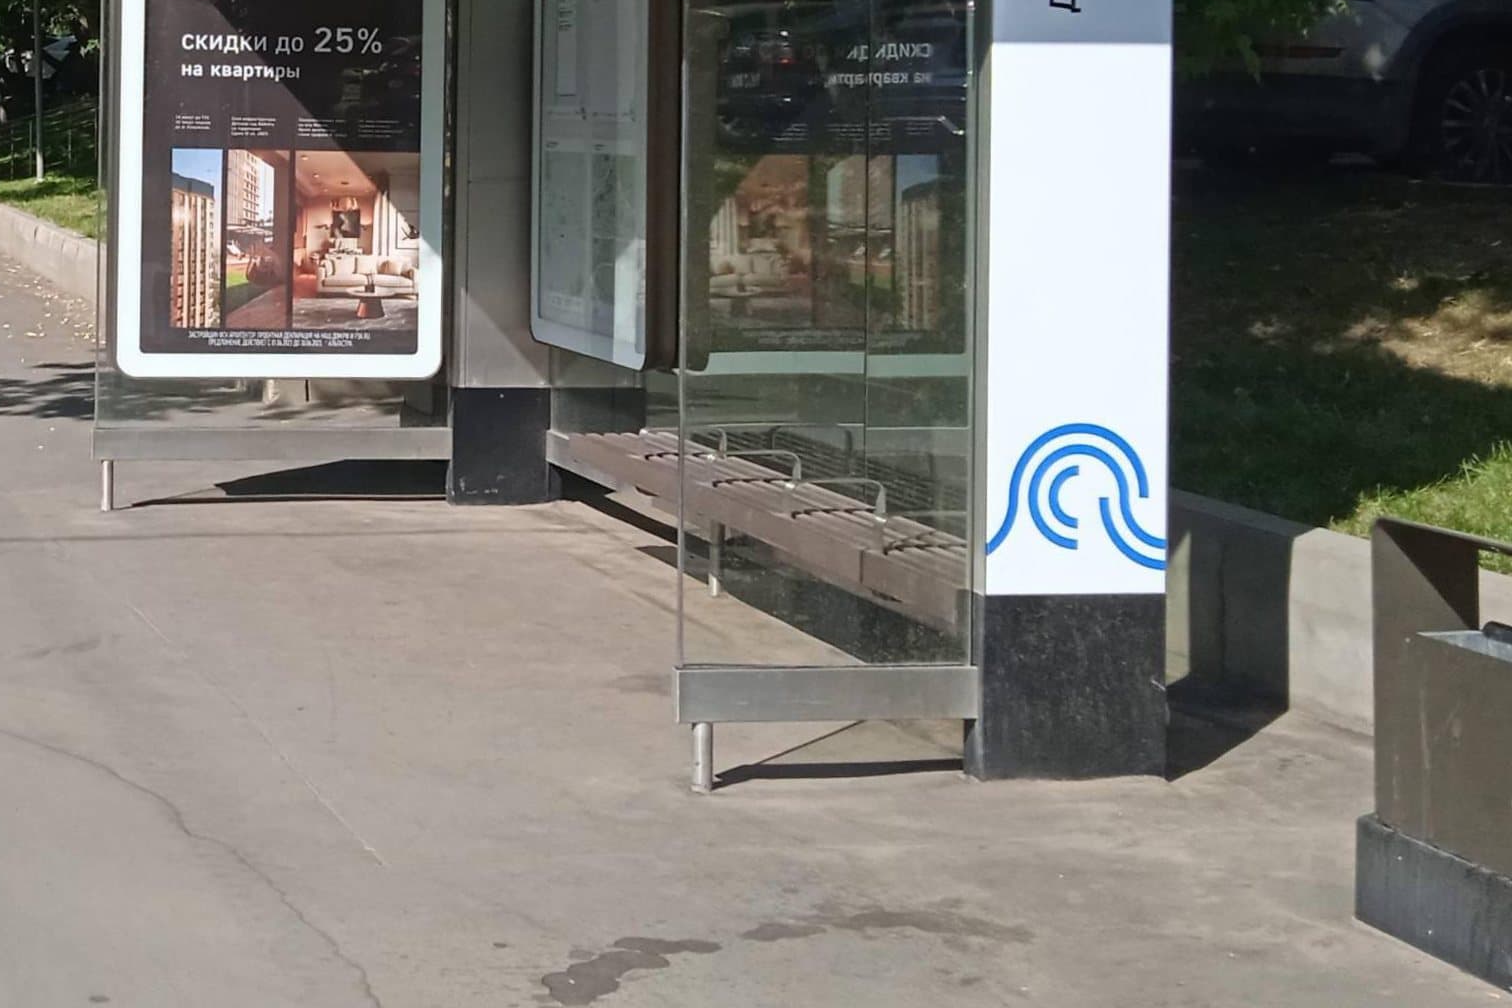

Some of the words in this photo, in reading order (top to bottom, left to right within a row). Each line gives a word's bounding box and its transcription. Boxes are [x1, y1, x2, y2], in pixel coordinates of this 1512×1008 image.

[181, 34, 268, 54] скидки
[275, 36, 304, 55] до
[313, 27, 383, 55] 25%
[181, 63, 203, 77] на
[210, 63, 300, 82] квартиры
